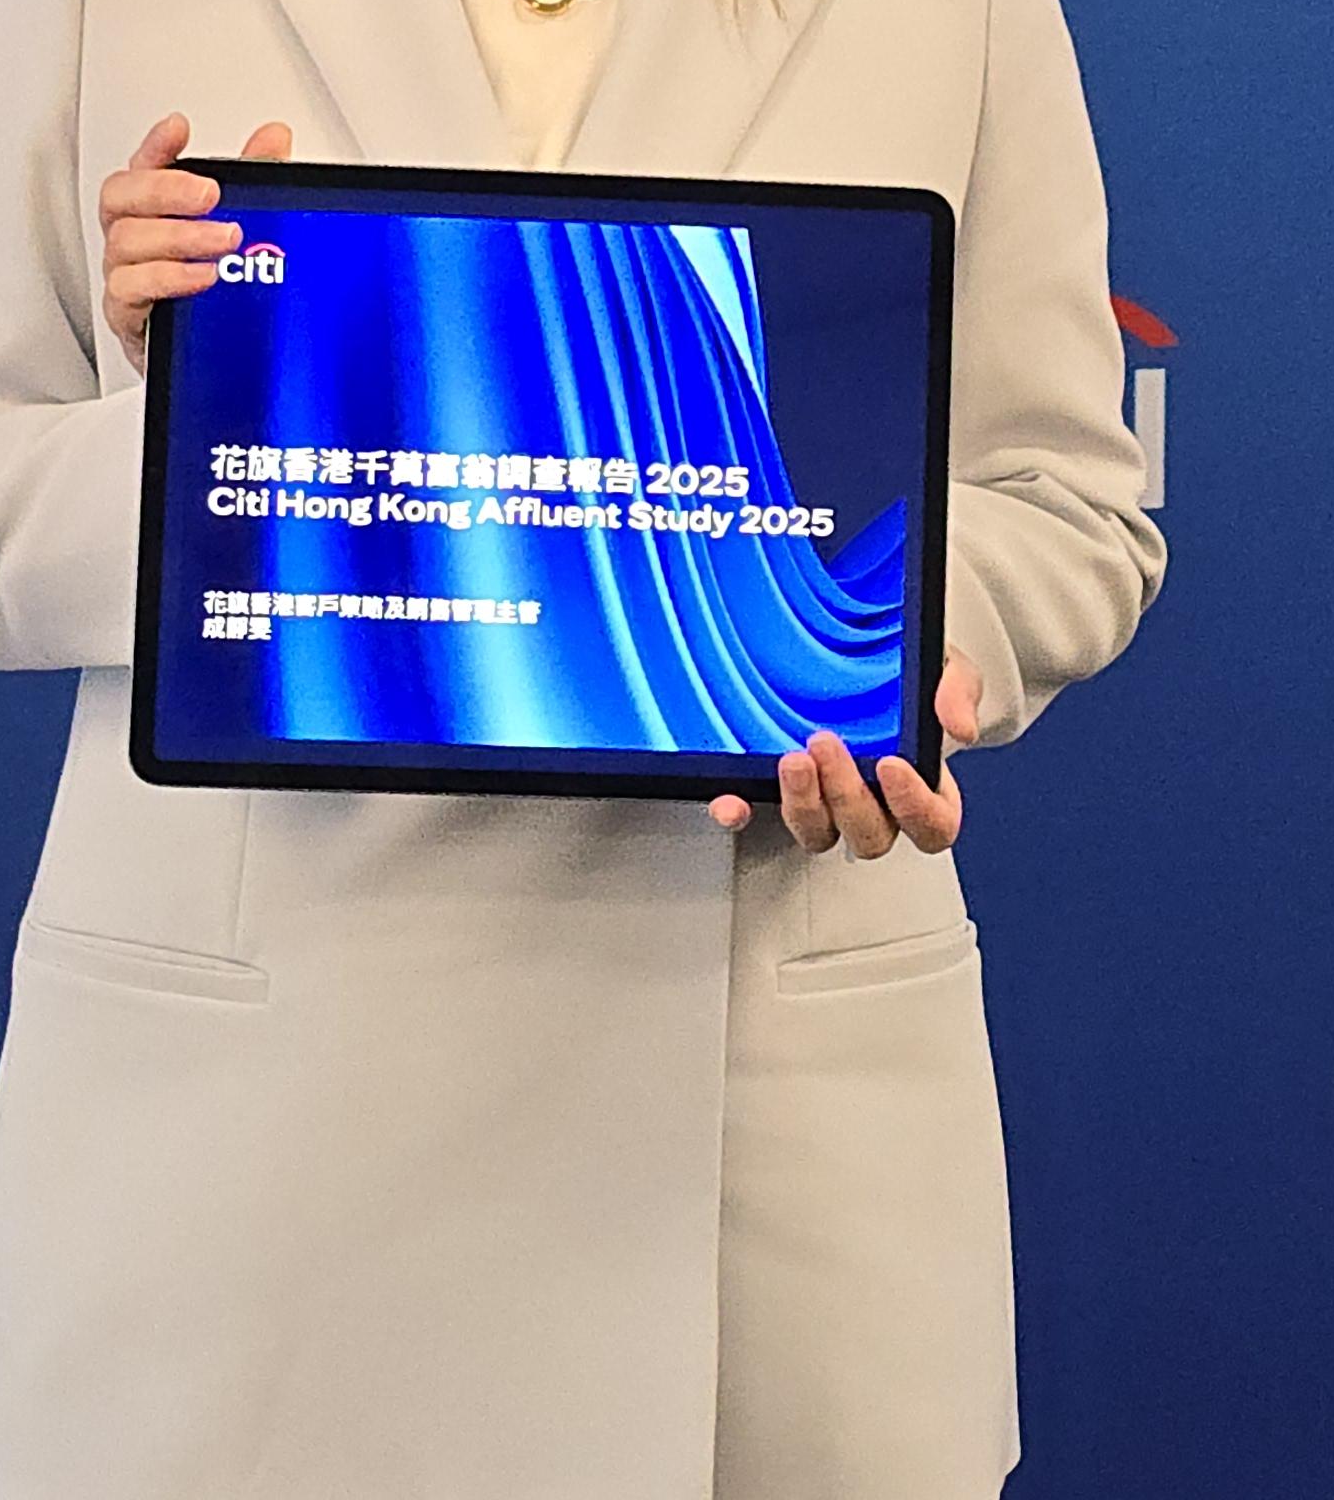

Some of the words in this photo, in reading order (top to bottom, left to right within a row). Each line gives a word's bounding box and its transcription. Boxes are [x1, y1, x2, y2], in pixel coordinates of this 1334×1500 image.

[218, 250, 284, 284] citi
[646, 462, 750, 498] 2025
[207, 486, 270, 517] Citi
[276, 489, 374, 526] Hong
[378, 493, 472, 530] Kong
[475, 496, 622, 529] Affluent
[627, 501, 734, 538] Study
[738, 504, 835, 537] 2025
